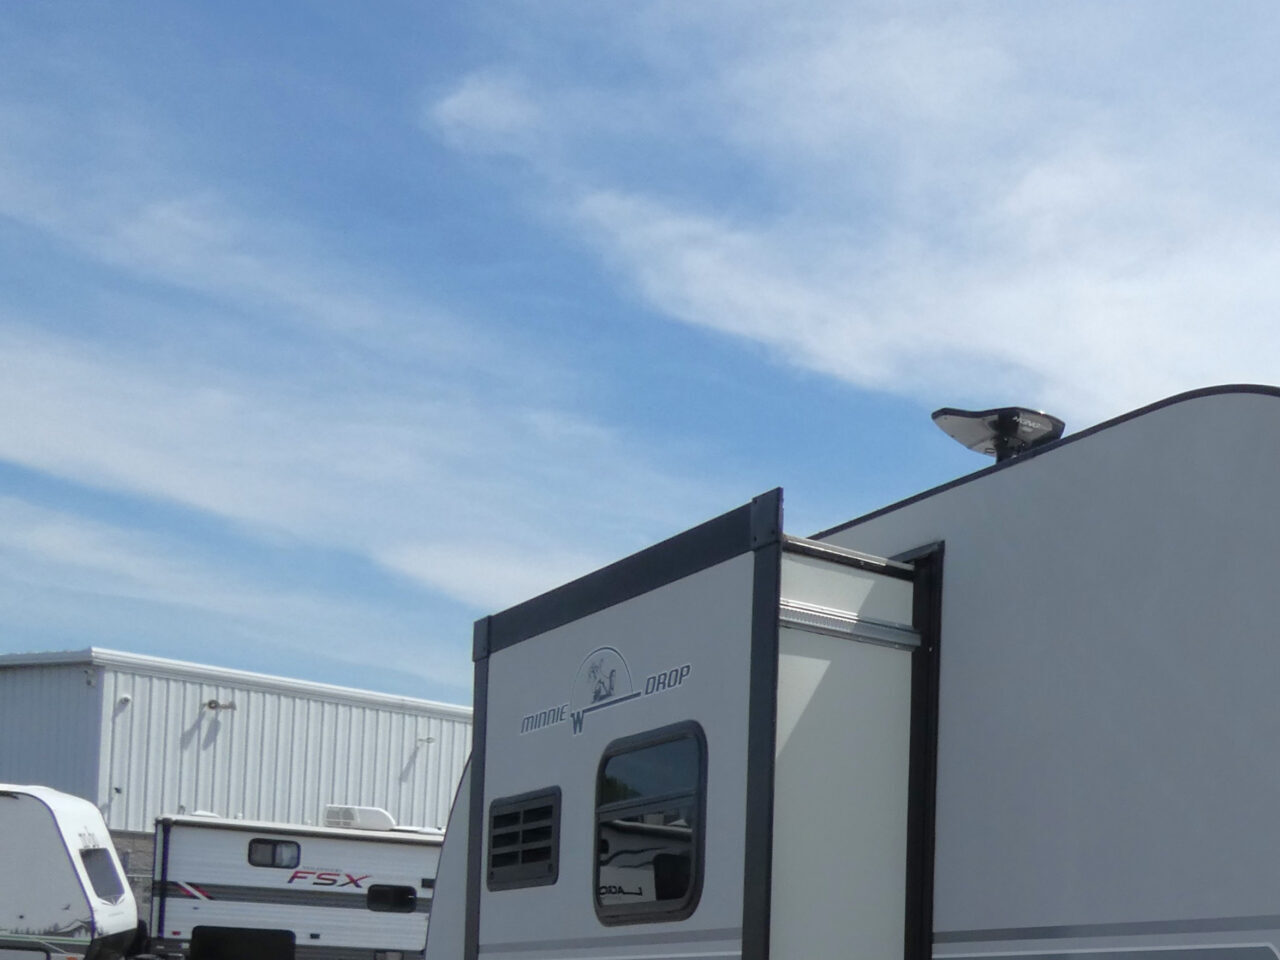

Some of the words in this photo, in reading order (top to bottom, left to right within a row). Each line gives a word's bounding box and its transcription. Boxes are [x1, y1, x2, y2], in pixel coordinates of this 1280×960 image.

[520, 703, 569, 734] MINNIE
[644, 664, 692, 696] DROP
[287, 870, 373, 889] FSX
